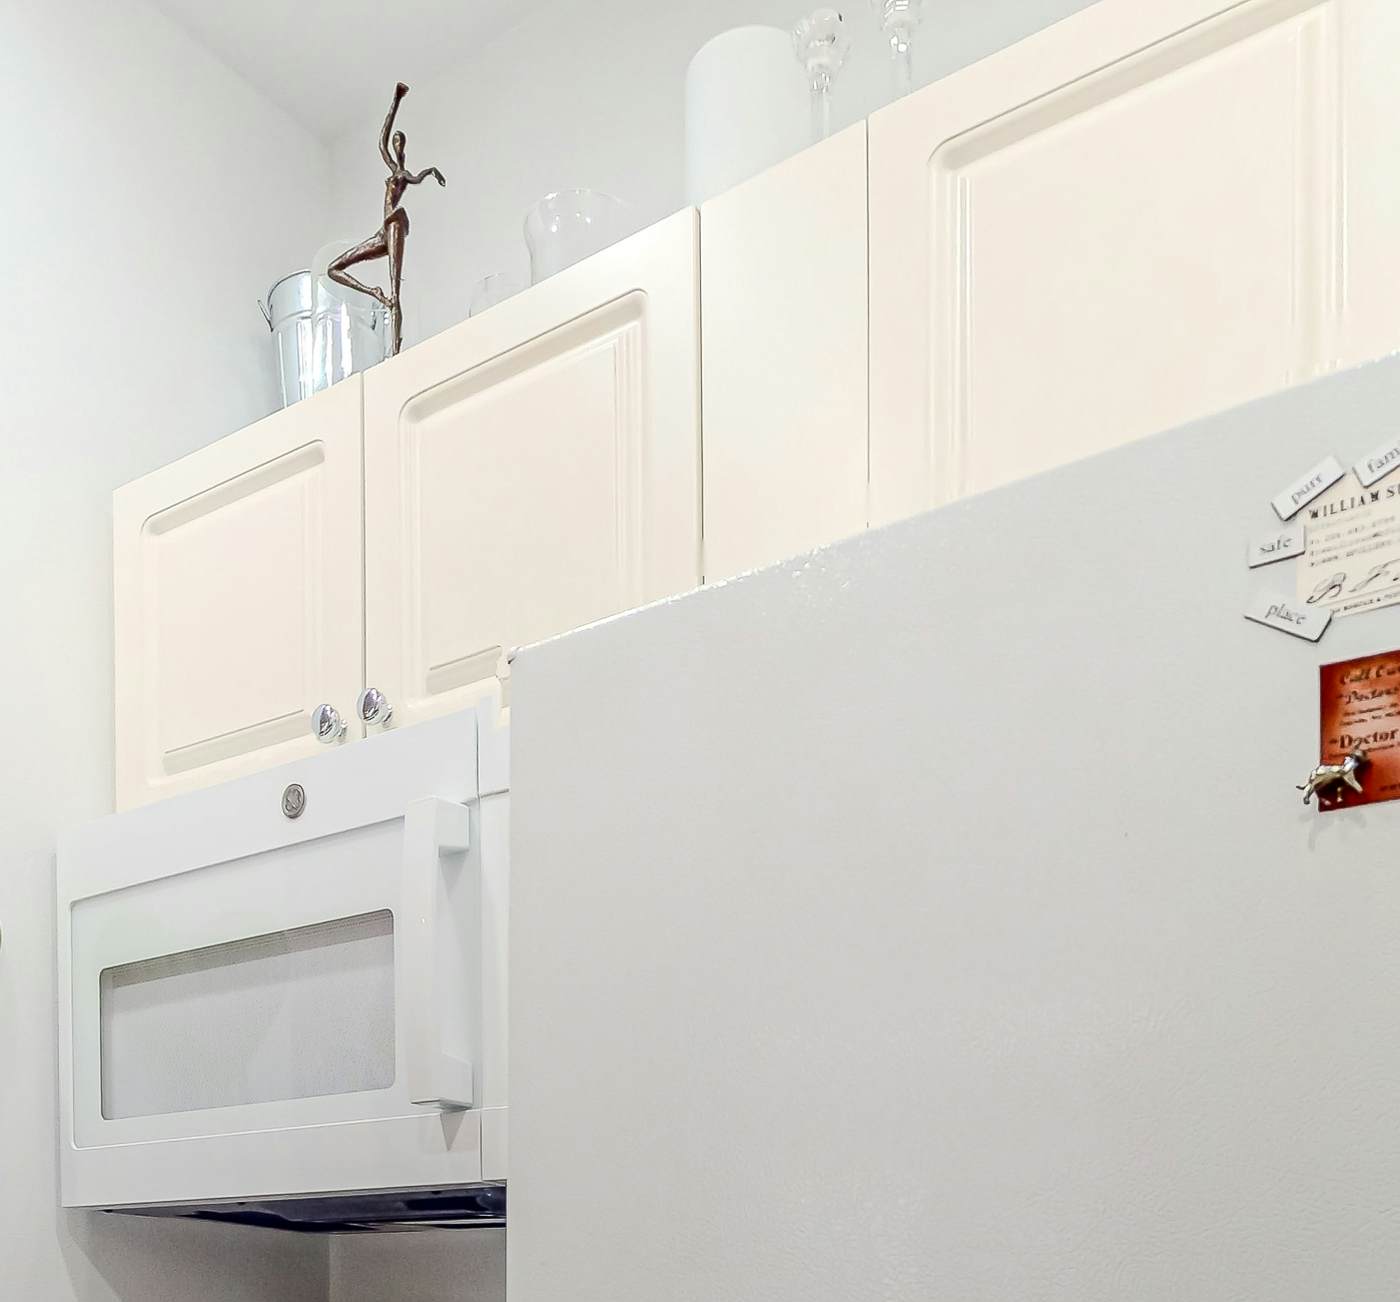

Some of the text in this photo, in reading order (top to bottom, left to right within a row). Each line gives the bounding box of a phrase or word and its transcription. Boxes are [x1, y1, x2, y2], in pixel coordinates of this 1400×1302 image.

[1291, 473, 1322, 504] purr
[1308, 490, 1379, 519] WILLIAM
[1260, 535, 1292, 553] safe
[1265, 603, 1307, 625] place
[1339, 729, 1399, 749] Doctor
